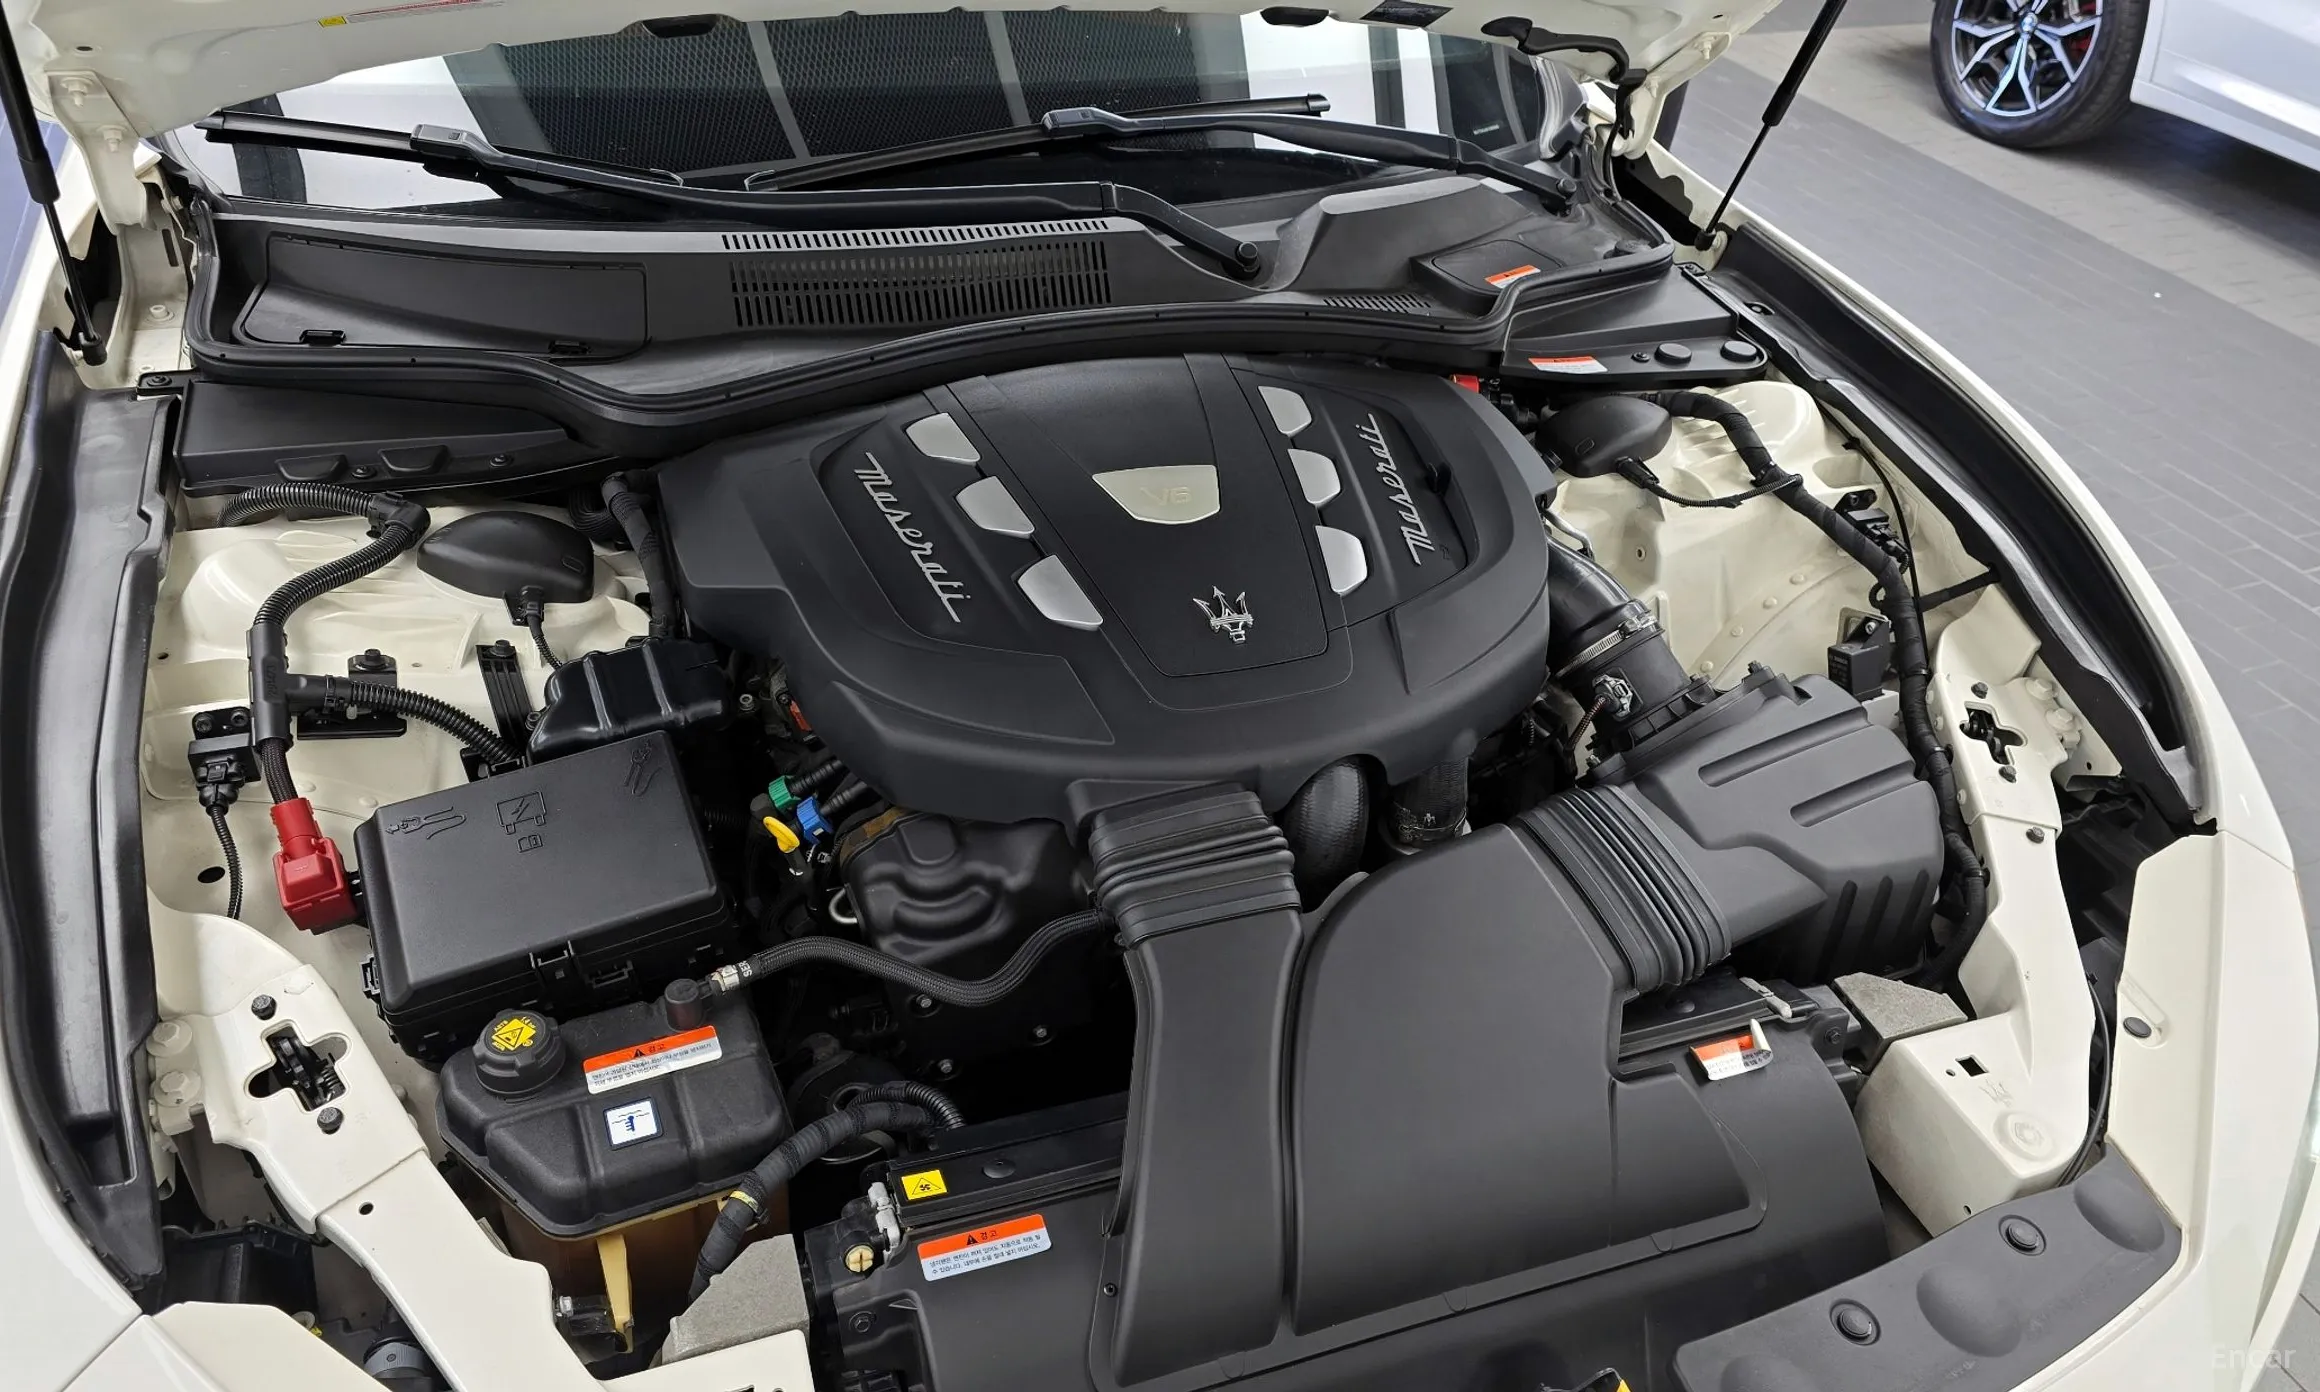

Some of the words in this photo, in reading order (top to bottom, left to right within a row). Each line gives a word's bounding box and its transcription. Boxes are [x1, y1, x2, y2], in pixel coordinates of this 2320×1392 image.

[854, 452, 971, 623] Maserati
[1139, 486, 1193, 507] V6
[1355, 413, 1435, 565] Maserati
